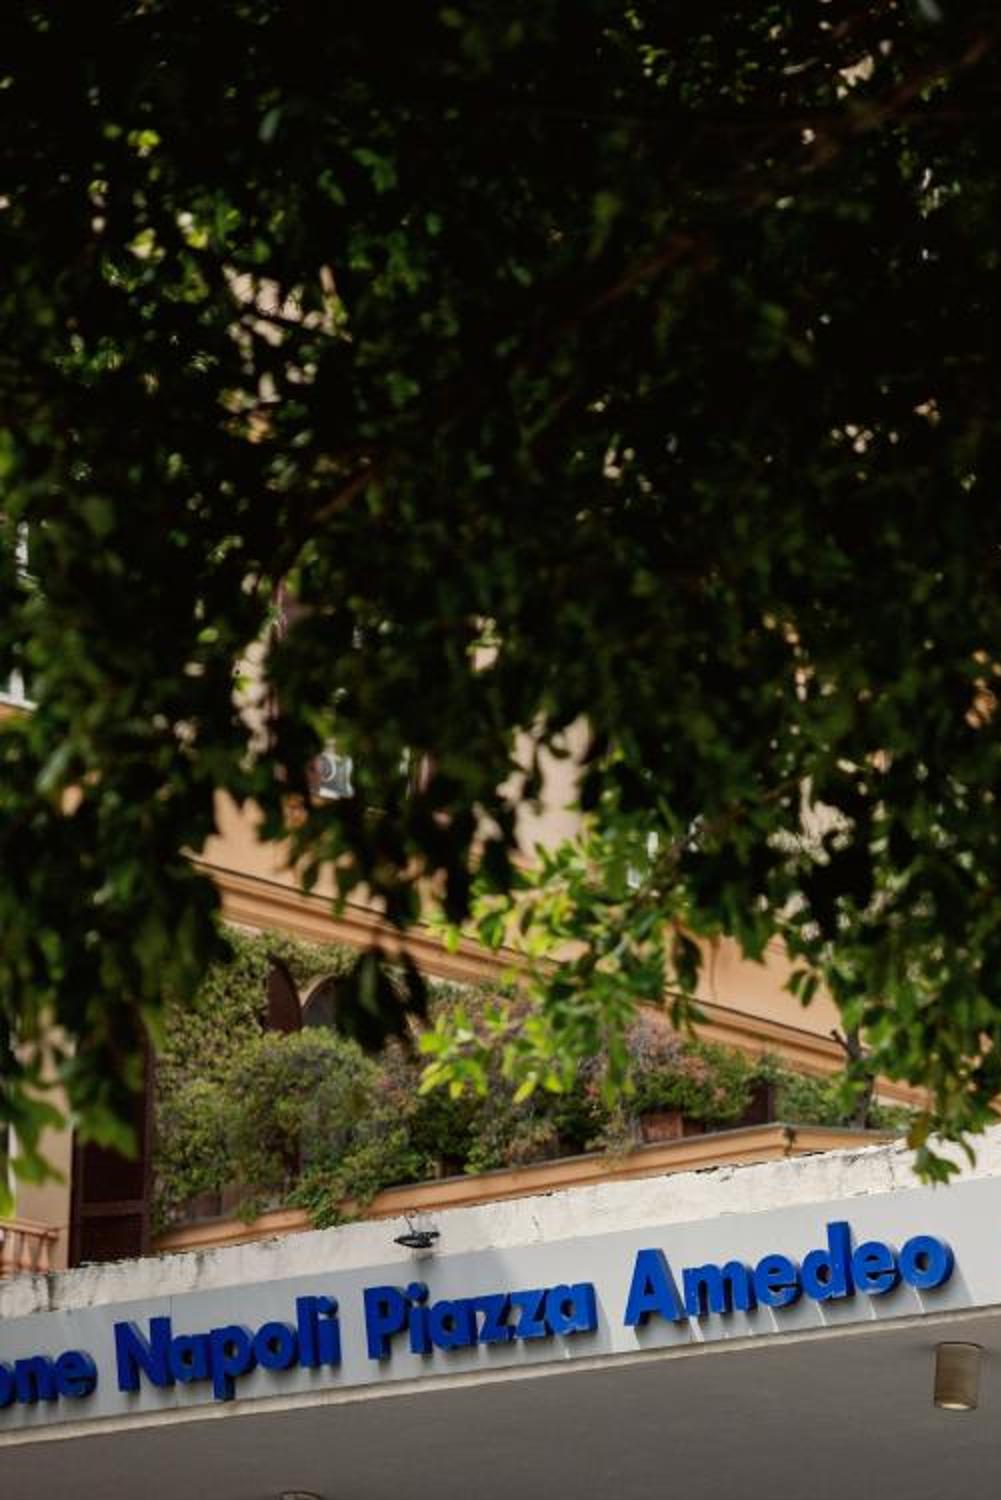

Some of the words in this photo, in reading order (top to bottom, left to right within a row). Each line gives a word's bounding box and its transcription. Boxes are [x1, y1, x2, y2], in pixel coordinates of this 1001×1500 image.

[114, 1295, 342, 1400] Napoli
[363, 1281, 598, 1360] Piazza
[624, 1220, 955, 1327] Amedeo
